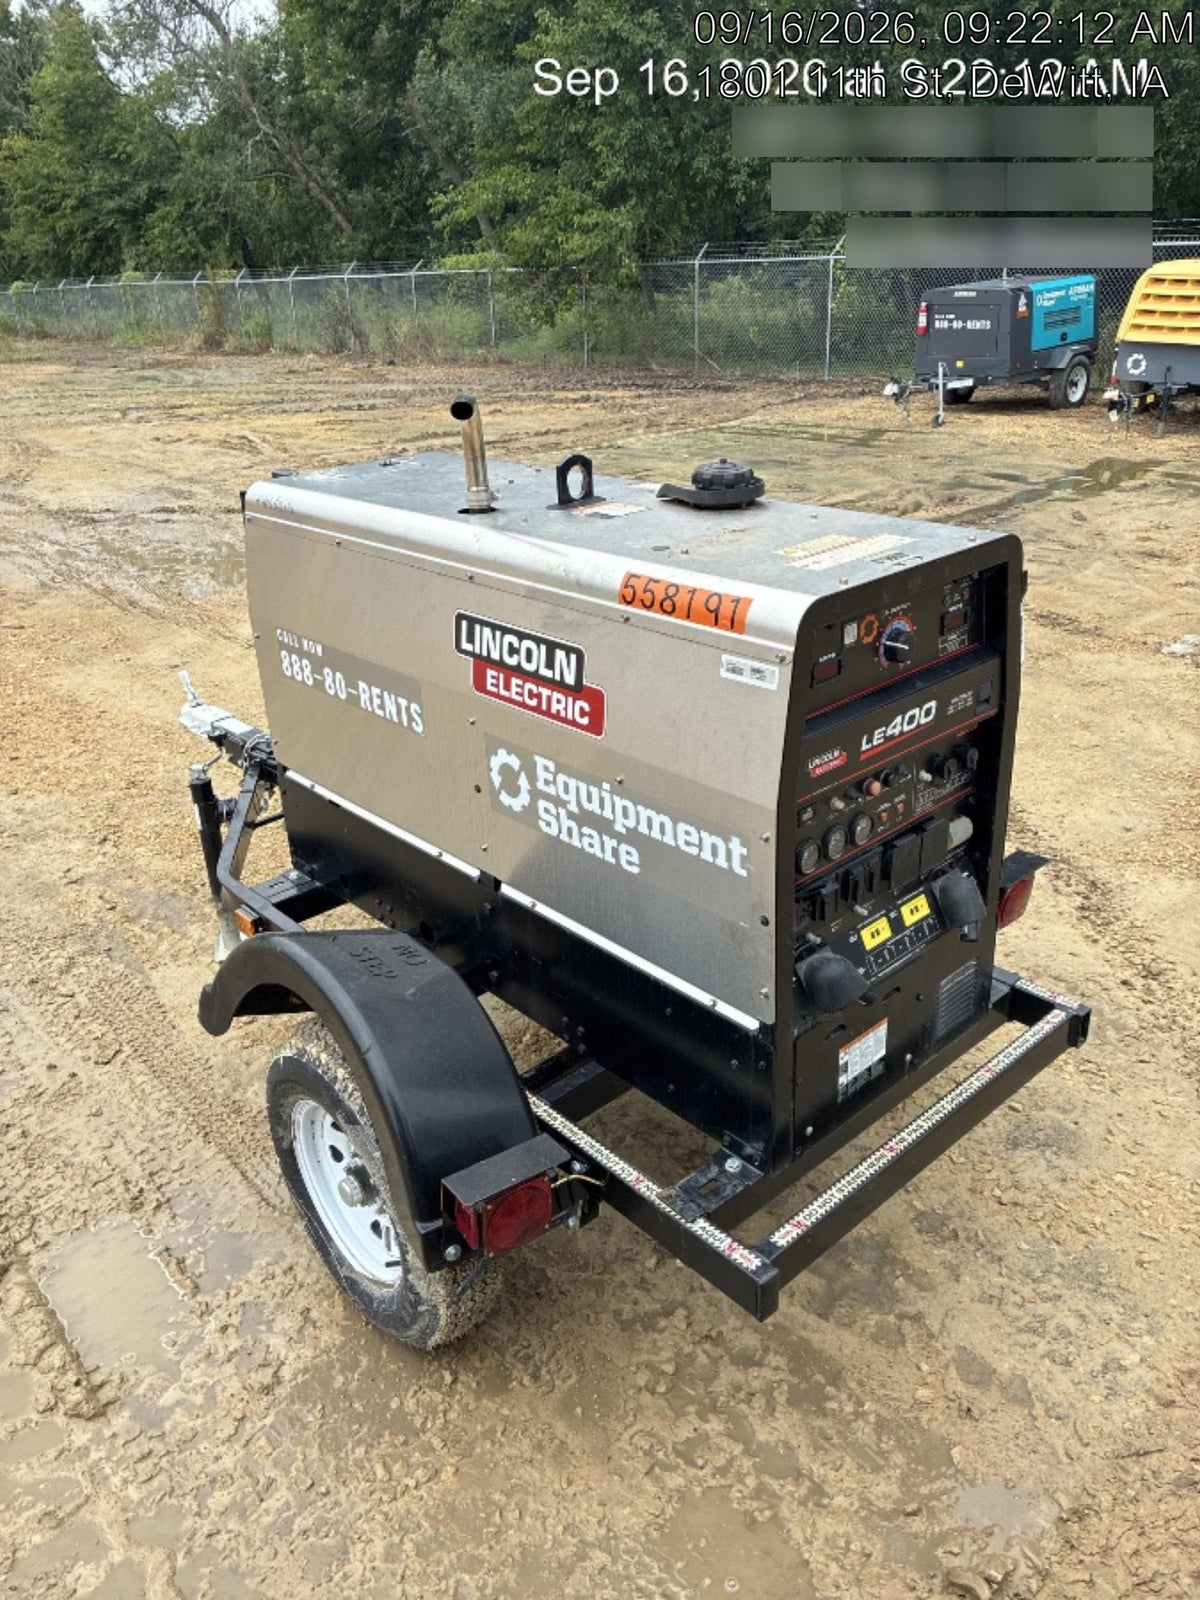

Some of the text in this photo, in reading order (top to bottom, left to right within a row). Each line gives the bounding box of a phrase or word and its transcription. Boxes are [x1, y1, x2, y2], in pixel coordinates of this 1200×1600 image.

[621, 572, 742, 631] 558191
[460, 619, 578, 686] LINCOLN
[280, 650, 425, 735] 888-80-RENTS
[486, 668, 590, 726] ELECTRIC
[861, 700, 937, 751] LE400
[533, 754, 748, 877] Equipment
[537, 798, 641, 874] Share
